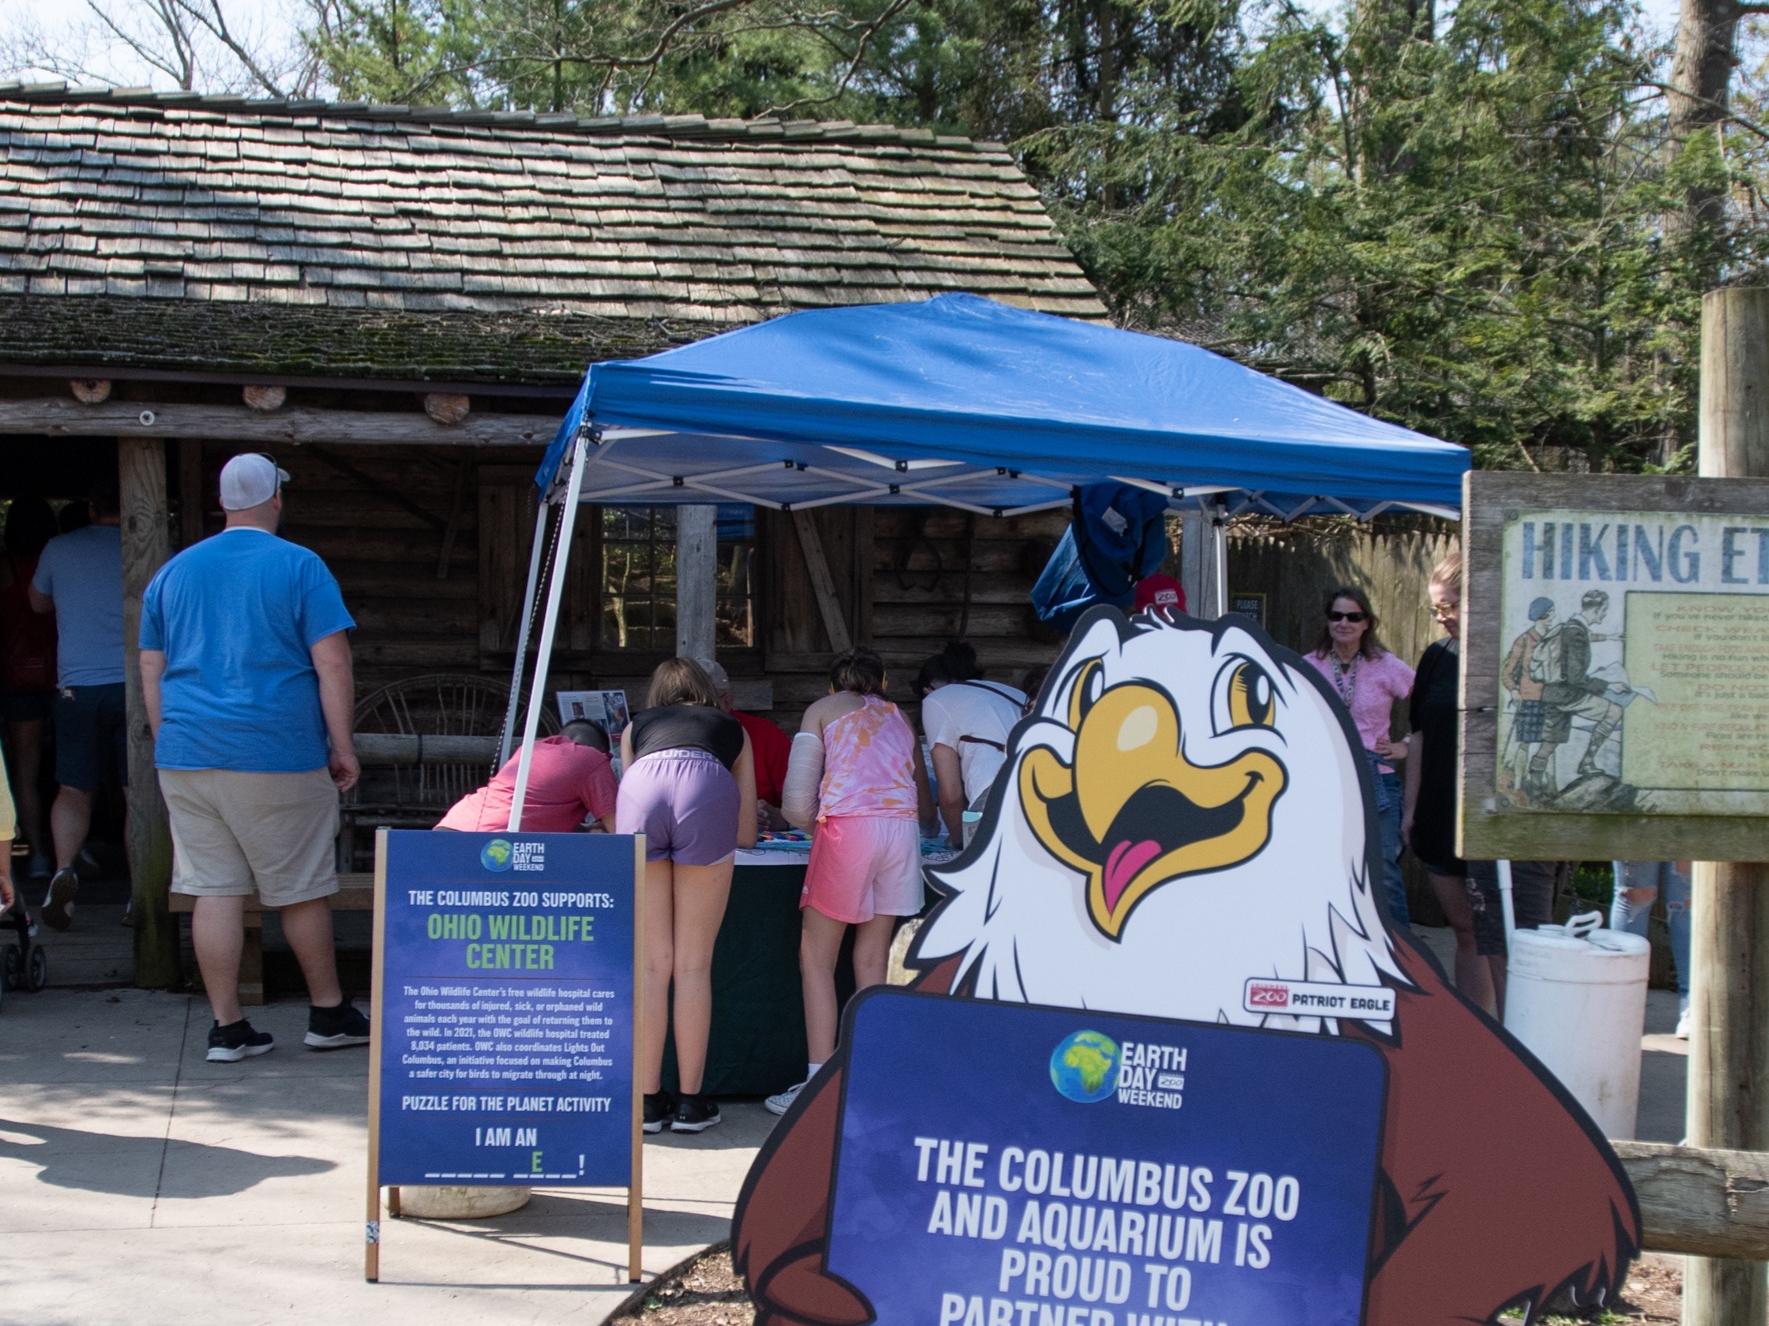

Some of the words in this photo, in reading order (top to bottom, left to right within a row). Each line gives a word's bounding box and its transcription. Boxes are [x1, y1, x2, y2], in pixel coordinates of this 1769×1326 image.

[1522, 522, 1700, 584] HIKING
[1676, 605, 1735, 613] KNOW
[1742, 606, 1769, 614] YO
[1704, 613, 1735, 621] never
[1655, 625, 1717, 633] CHECK
[1685, 663, 1747, 673] PEOPLE
[1698, 683, 1725, 692] DO
[513, 843, 544, 853] EARTH
[513, 854, 530, 863] DAY
[408, 890, 434, 905] THE
[437, 891, 509, 907] COLUMBUS
[512, 892, 538, 907] ZOO
[542, 893, 614, 908] SUPPORTS:
[427, 914, 481, 940] OHIO
[489, 915, 594, 941] WILDLIFE
[466, 943, 554, 969] CENTER
[404, 986, 418, 996] The
[421, 987, 438, 996] Ohio
[440, 987, 470, 996] Wildlife
[473, 987, 506, 996] Center's
[508, 988, 524, 997] free
[526, 988, 556, 997] wildlife
[558, 988, 590, 999] hospital
[592, 990, 615, 998] cares
[415, 1000, 427, 1009] for
[428, 1000, 469, 1009] thousands
[472, 1001, 480, 1010] of
[481, 1001, 512, 1011] injured,
[515, 1002, 534, 1012] sick,
[546, 1002, 584, 1012] orphaned
[586, 1002, 603, 1011] wild
[1293, 994, 1346, 1008] PATRIOT
[1351, 998, 1390, 1011] EAGLE
[404, 1014, 435, 1023] animals
[437, 1014, 456, 1023] each
[459, 1016, 477, 1025] year
[478, 1015, 496, 1023] with
[498, 1015, 511, 1024] the
[513, 1015, 530, 1026] goal
[533, 1015, 541, 1024] of
[542, 1016, 580, 1026] returning
[582, 1016, 602, 1025] them
[604, 1017, 613, 1025] to
[407, 1028, 420, 1036] the
[422, 1028, 442, 1037] wild.
[444, 1028, 452, 1037] In
[454, 1028, 476, 1038] 2021,
[478, 1028, 490, 1037] the
[493, 1028, 512, 1037] OWC
[514, 1029, 543, 1038] wildlife
[546, 1029, 578, 1040] hospital
[580, 1030, 610, 1038] treated
[411, 1041, 435, 1051] 8,034
[437, 1042, 472, 1052] patients.
[475, 1042, 493, 1051] OWC
[495, 1042, 512, 1051] also
[514, 1043, 562, 1052] coordinates
[564, 1043, 589, 1054] Lights
[591, 1043, 605, 1052] Out
[402, 1054, 444, 1066] Columbus,
[459, 1055, 494, 1065] initiative
[496, 1056, 528, 1065] focused
[542, 1056, 571, 1067] making
[574, 1056, 612, 1066] Columbus
[1121, 1042, 1188, 1071] EARTH
[409, 1070, 414, 1078] a
[416, 1069, 437, 1078] safer
[439, 1069, 454, 1080] city
[456, 1069, 467, 1078] for
[469, 1069, 489, 1078] birds
[502, 1070, 533, 1081] migrate
[535, 1070, 567, 1081] through
[569, 1071, 577, 1079] at
[579, 1070, 602, 1081] night.
[1119, 1065, 1157, 1091] DAY
[402, 1096, 449, 1111] PUZZLE
[452, 1096, 476, 1111] FOR
[480, 1097, 503, 1111] THE
[507, 1097, 554, 1112] PLANET
[556, 1097, 611, 1112] ACTIVITY
[1118, 1089, 1183, 1110] WEEKEND
[475, 1128, 481, 1147] I
[485, 1128, 511, 1147] AM
[515, 1128, 537, 1147] AN
[914, 1136, 989, 1188] THE
[998, 1146, 1213, 1212] COLUMBUS
[1223, 1170, 1300, 1221] ZOO
[927, 1190, 1009, 1240] AND
[1016, 1200, 1224, 1264] AQUARIUM
[1234, 1222, 1273, 1269] IS
[999, 1248, 1132, 1304] PROUD
[1144, 1264, 1192, 1312] TO
